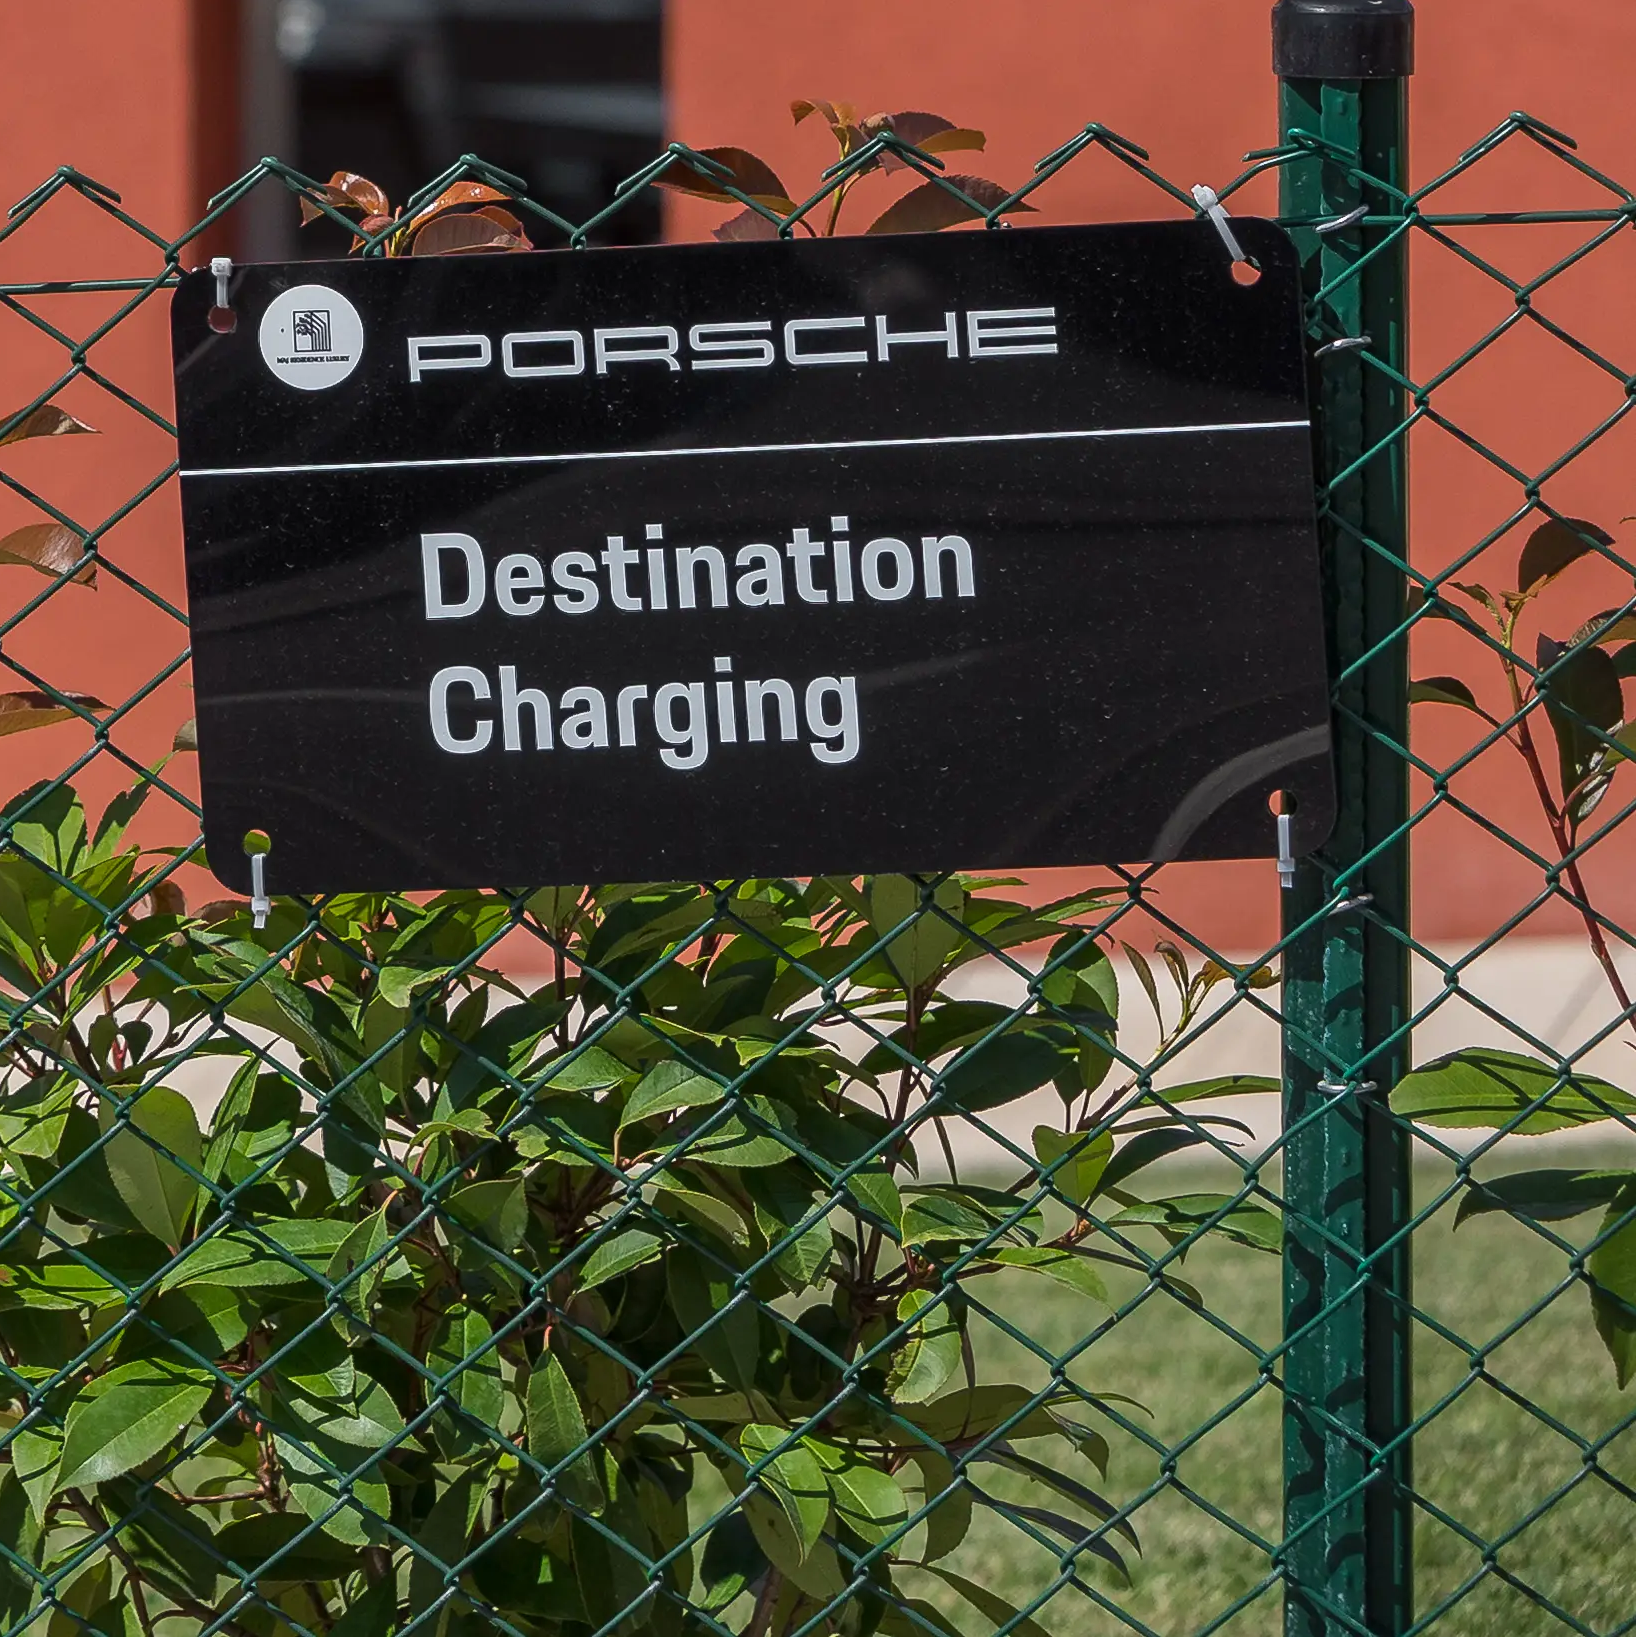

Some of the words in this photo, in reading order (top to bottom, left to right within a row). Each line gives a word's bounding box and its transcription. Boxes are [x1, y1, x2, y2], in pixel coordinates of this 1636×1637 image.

[406, 306, 1059, 383] PORSCHE
[420, 515, 976, 621] Destination
[429, 656, 860, 770] Charging
